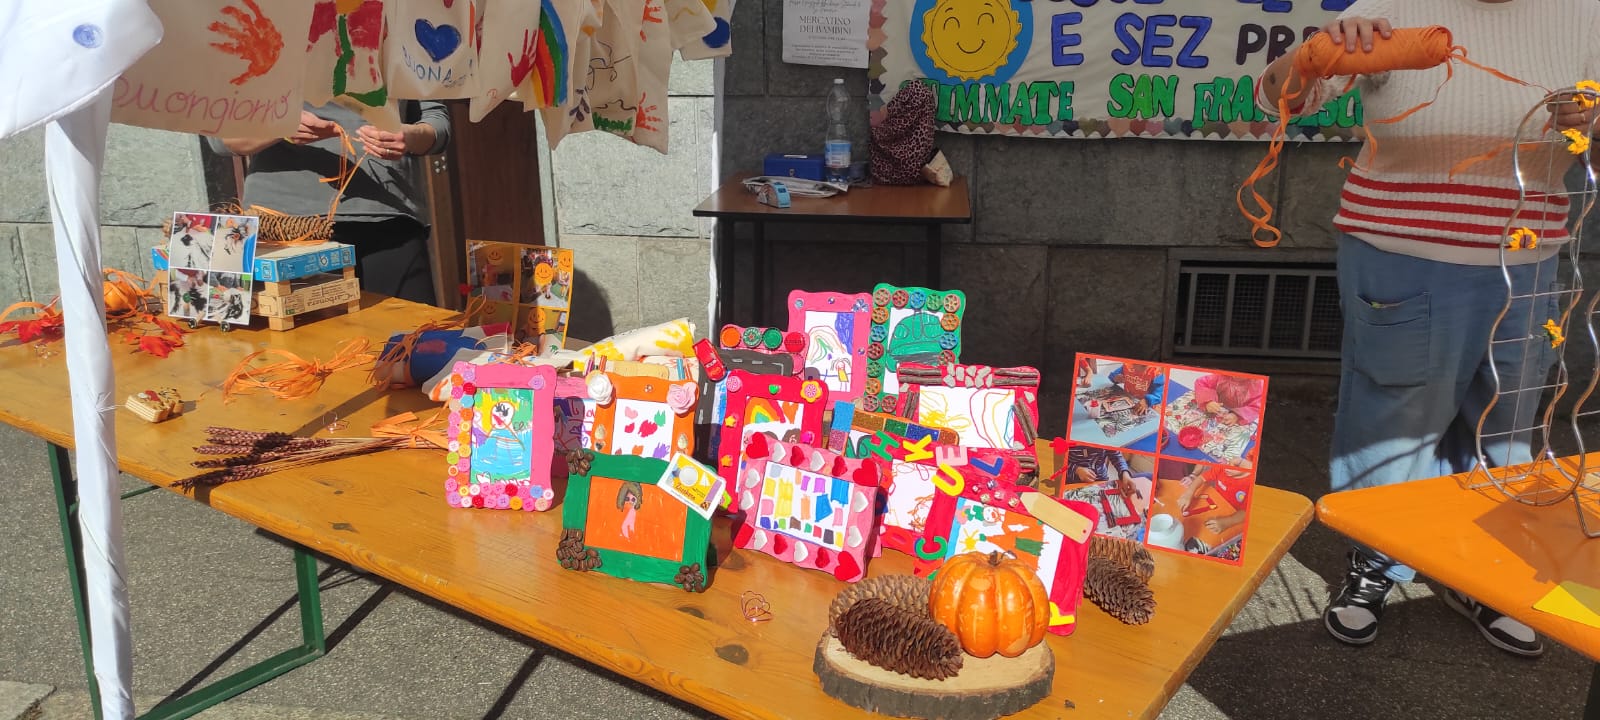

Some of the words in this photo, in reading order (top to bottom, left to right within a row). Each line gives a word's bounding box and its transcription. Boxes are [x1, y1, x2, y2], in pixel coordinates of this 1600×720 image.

[799, 15, 851, 26] MERCATINO
[815, 25, 852, 35] BAMBINI
[1051, 12, 1084, 67] E
[1111, 12, 1212, 69] SEZ
[1236, 23, 1321, 66] PR
[1107, 73, 1179, 119] SAN
